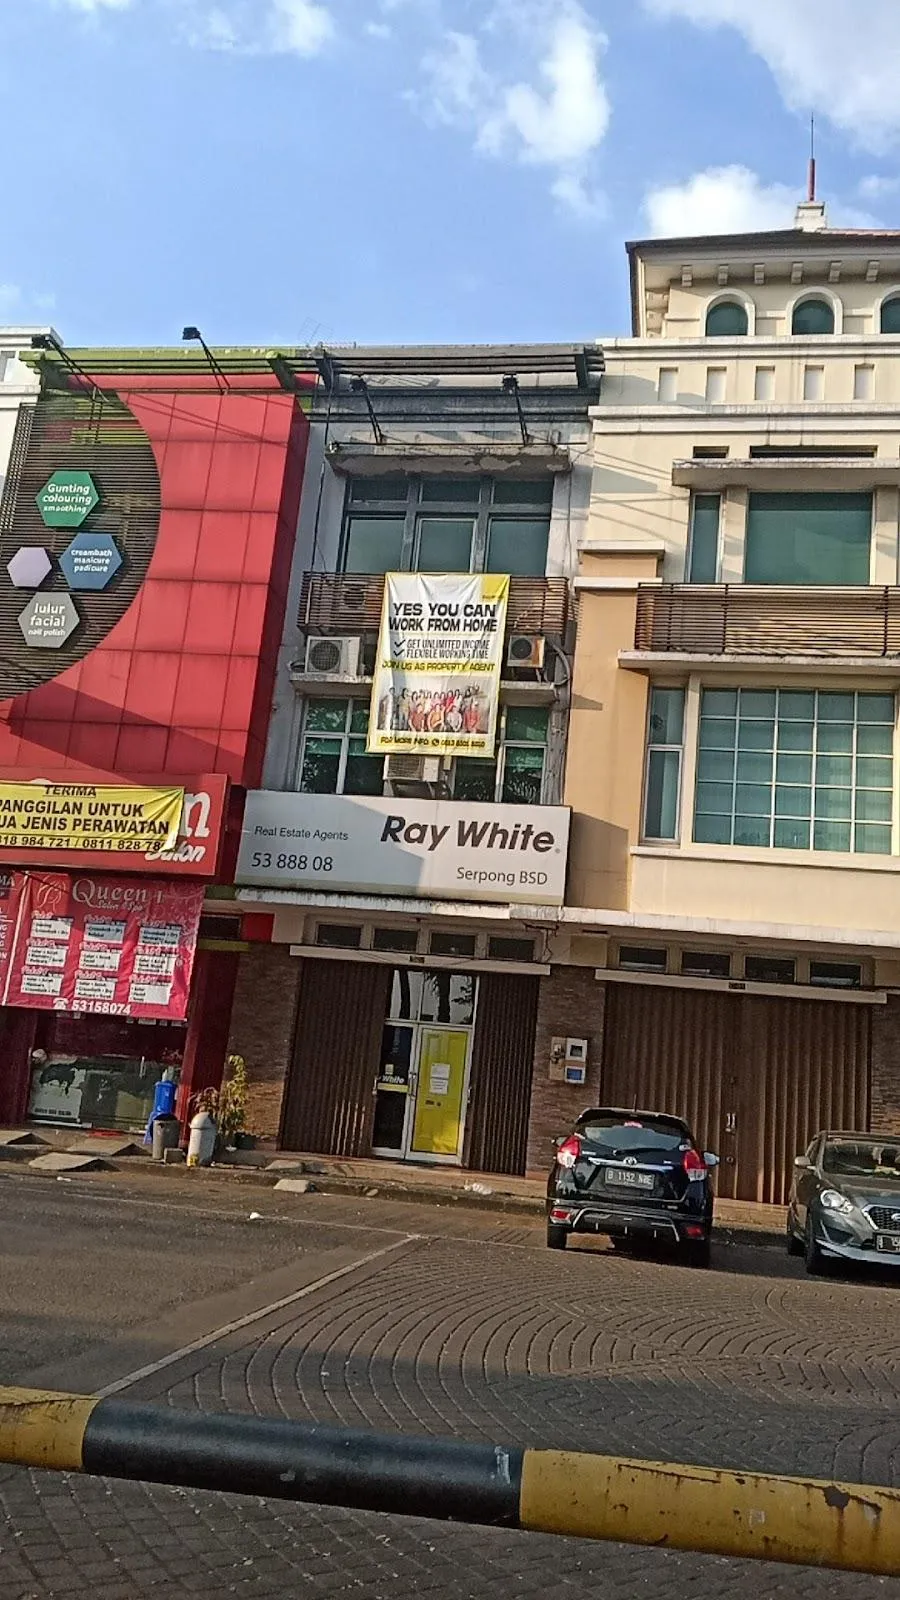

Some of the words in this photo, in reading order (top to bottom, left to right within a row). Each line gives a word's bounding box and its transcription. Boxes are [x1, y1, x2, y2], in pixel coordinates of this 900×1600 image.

[48, 483, 90, 496] Gunting
[42, 494, 92, 506] colouring
[43, 505, 87, 513] smoothing
[74, 557, 110, 565] manicure
[74, 565, 109, 573] pedicure
[34, 603, 65, 614] lulur
[393, 602, 423, 616] YES
[428, 603, 458, 617] YOU
[463, 604, 496, 618] CAN
[30, 614, 66, 627] facial
[389, 617, 423, 631] WORK
[427, 619, 460, 632] FROM
[462, 619, 497, 632] HOME
[28, 628, 43, 636] nail
[43, 629, 66, 637] polish
[406, 639, 421, 649] GET
[422, 639, 460, 649] UNLIMITED
[462, 640, 490, 650] INCOME
[406, 649, 437, 659] FLEXIBLE
[439, 649, 471, 660] WORKING
[382, 660, 400, 669] JOIN
[401, 662, 412, 671] US
[414, 662, 425, 671] AS
[427, 662, 467, 672] PROPERTY
[469, 663, 495, 672] AGENT
[44, 785, 97, 797] TERIMA
[0, 800, 83, 815] ANGGILAN
[88, 802, 145, 817] UNTUK
[21, 816, 68, 831] JENIS
[72, 817, 169, 835] PERAWATAN
[254, 825, 277, 837] Real
[279, 826, 311, 839] Estate
[312, 829, 349, 843] Agents
[380, 815, 450, 851] Ray
[456, 819, 556, 853] White
[21, 836, 44, 847] 984
[49, 837, 70, 847] 721
[82, 838, 113, 850] 0811
[117, 839, 141, 850] 828
[145, 839, 165, 851] 78
[251, 852, 272, 868] 53
[276, 853, 308, 870] 888
[312, 855, 333, 872] 08
[456, 866, 516, 886] Serpong
[519, 870, 548, 886] BSD
[73, 879, 147, 908] Queen
[71, 999, 131, 1015] 53158074
[608, 1170, 614, 1180] B
